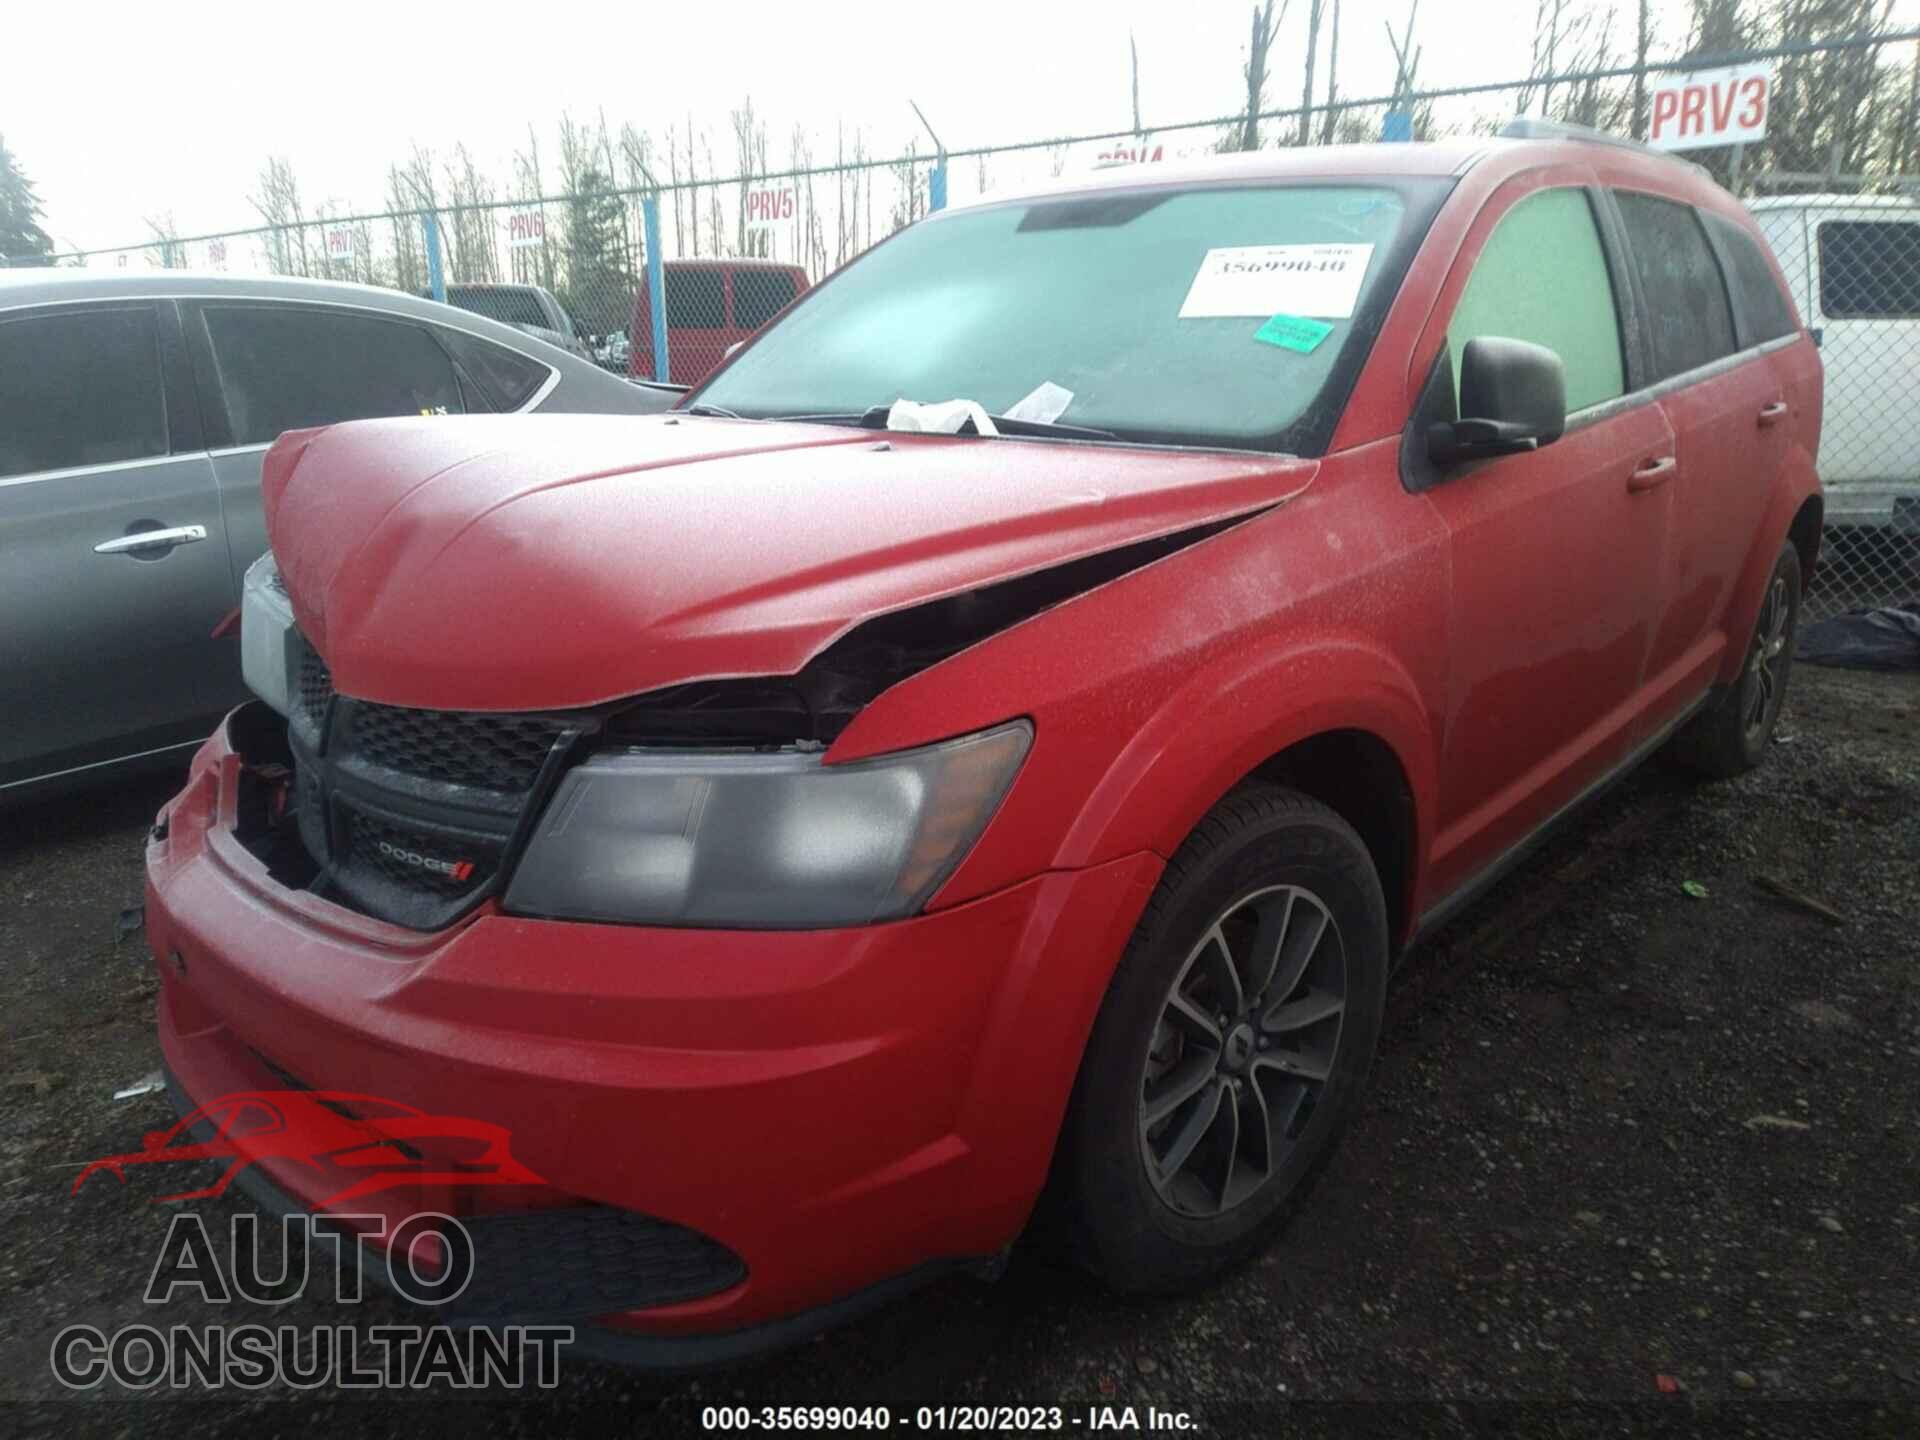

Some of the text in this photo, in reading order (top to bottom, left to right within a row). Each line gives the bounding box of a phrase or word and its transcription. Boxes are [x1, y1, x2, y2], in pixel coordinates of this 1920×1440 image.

[1651, 74, 1767, 140] PRV3
[750, 187, 793, 222] PRV5
[329, 229, 353, 252] PRV7
[510, 211, 542, 240] PRV6
[379, 841, 457, 876] DODGE
